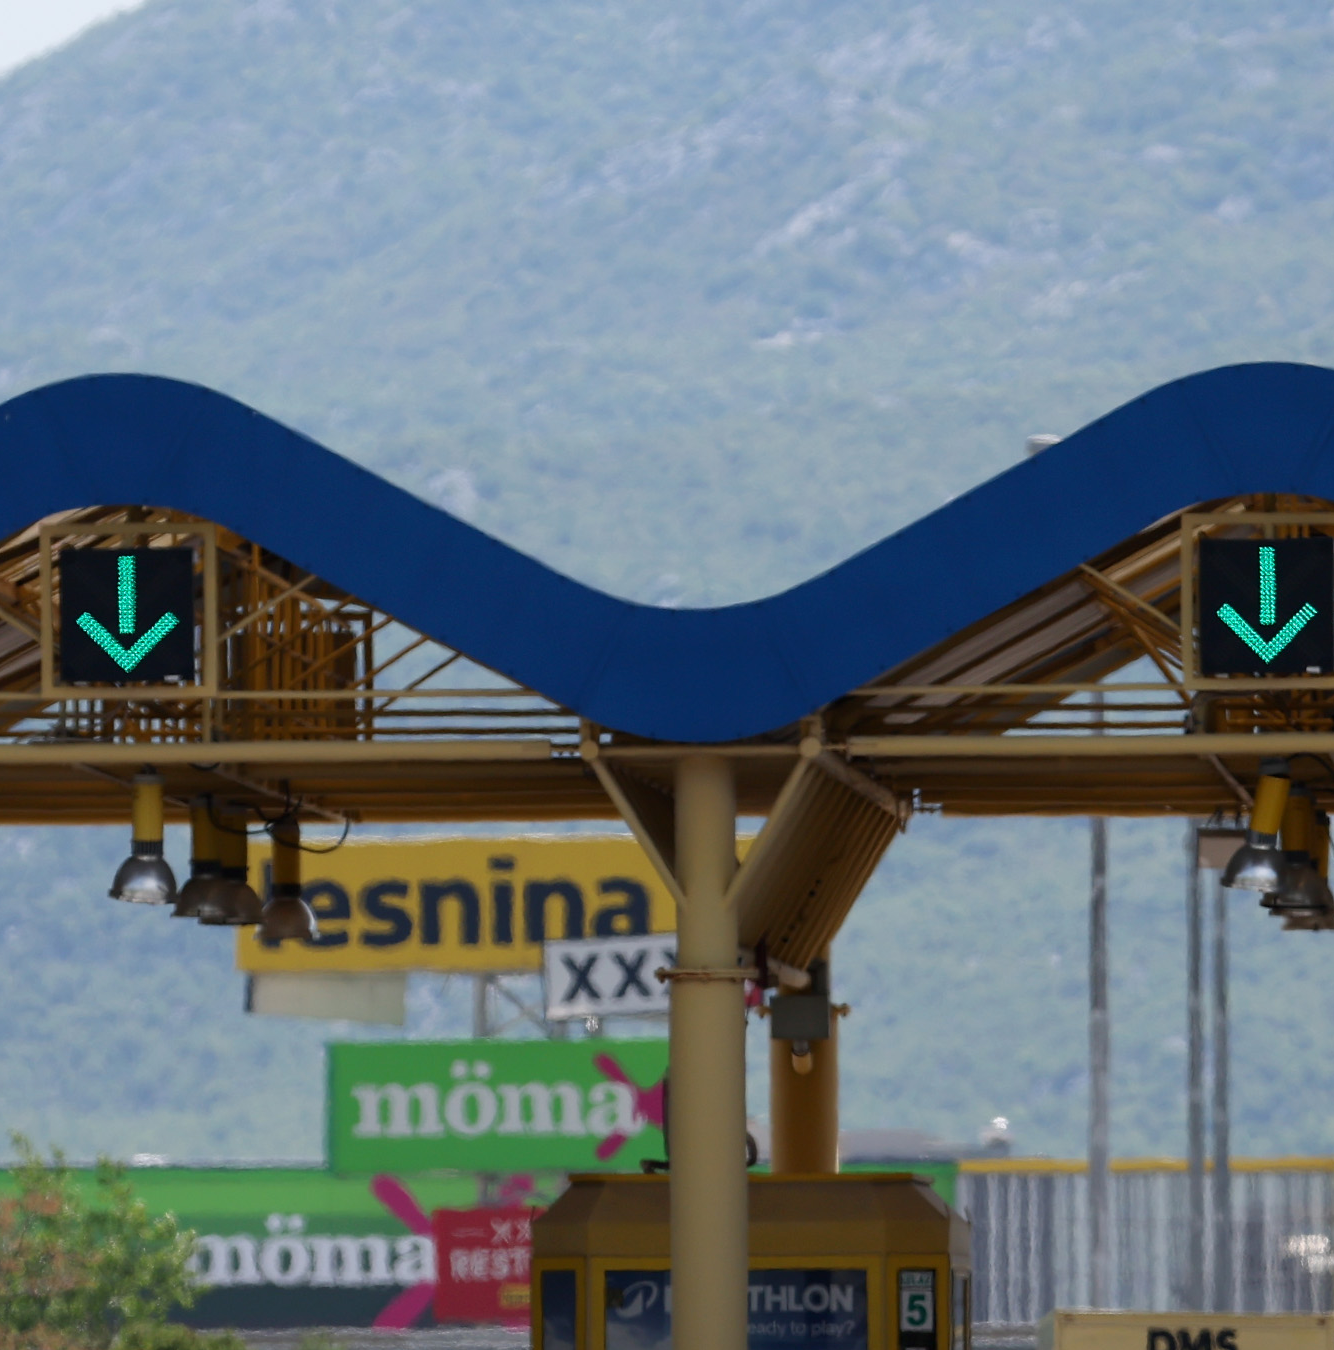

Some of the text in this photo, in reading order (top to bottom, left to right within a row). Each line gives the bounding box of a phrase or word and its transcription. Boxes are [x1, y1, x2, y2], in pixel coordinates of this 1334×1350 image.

[352, 1059, 646, 1137] möma
[188, 1213, 437, 1287] möma
[664, 1284, 854, 1313] THLON
[906, 1293, 928, 1327] 5
[748, 1320, 855, 1338] eady to play?
